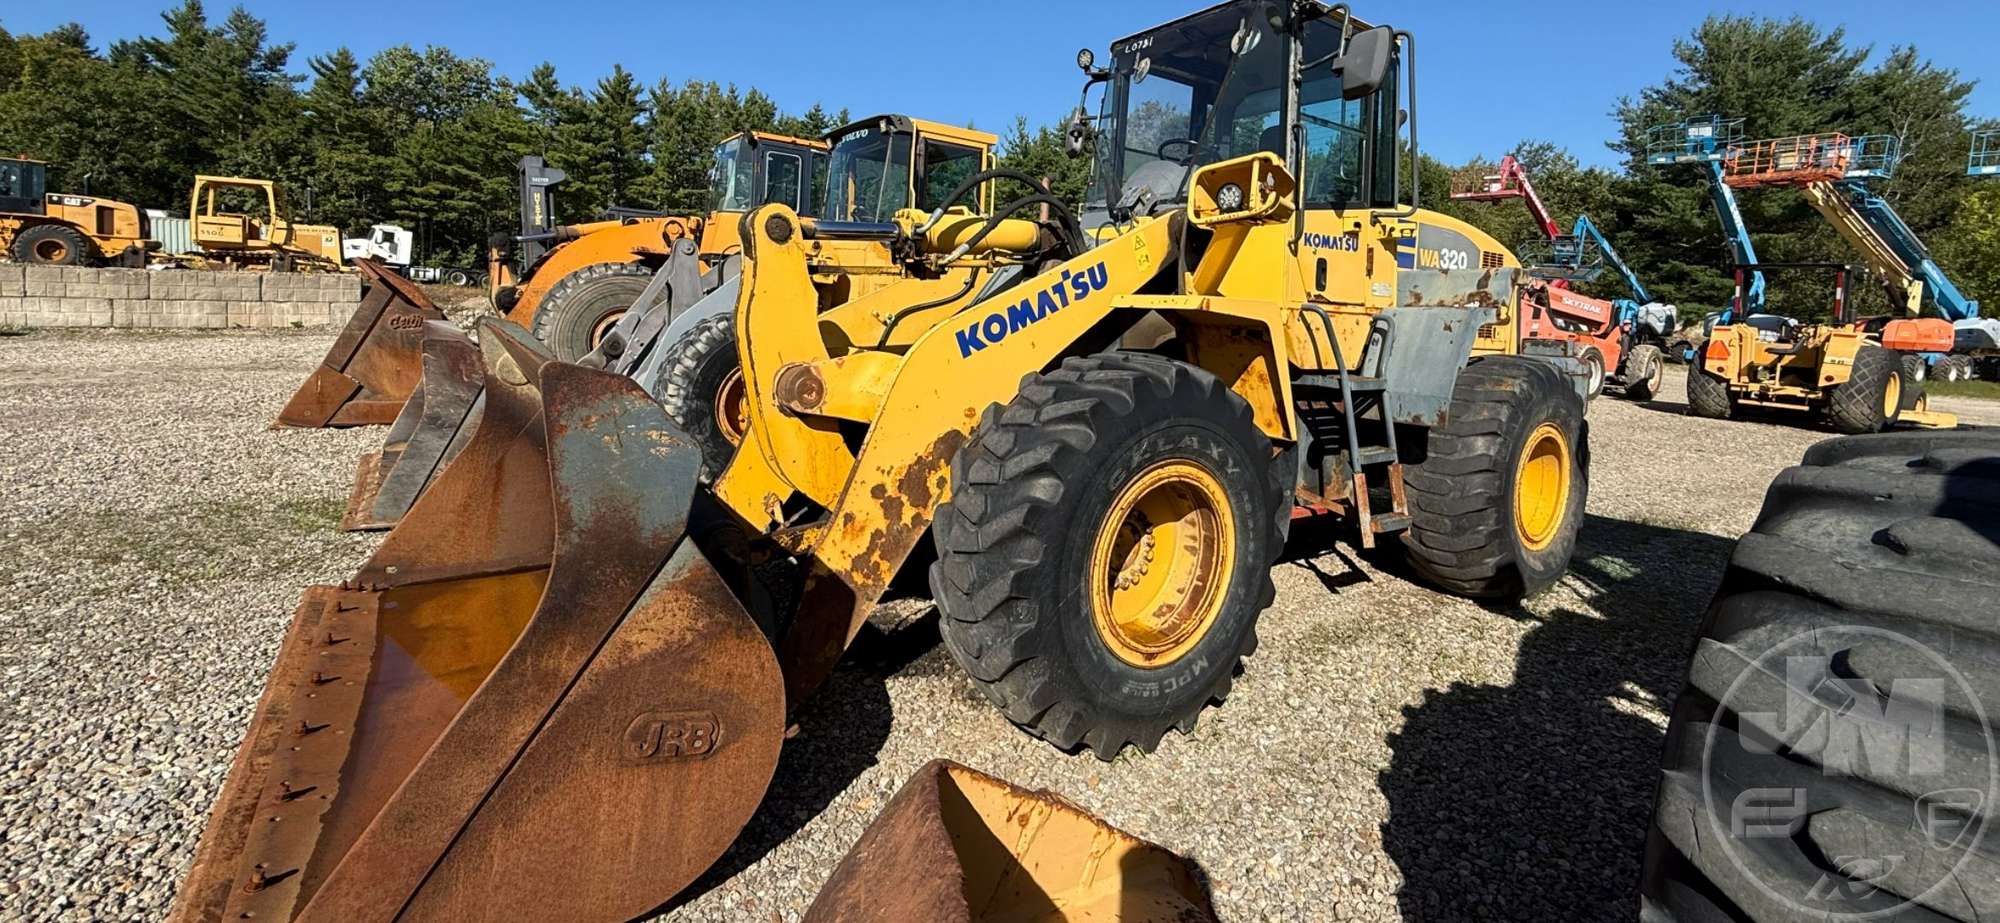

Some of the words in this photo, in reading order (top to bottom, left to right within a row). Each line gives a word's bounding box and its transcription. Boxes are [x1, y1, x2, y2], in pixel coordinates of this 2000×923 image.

[64, 197, 81, 206] CAT
[1303, 232, 1360, 252] KOMATSU
[1419, 247, 1468, 270] WA320
[955, 261, 1109, 359] KOMATSU
[1561, 296, 1602, 315] SKYTRAK
[1163, 655, 1209, 694] MPC
[629, 720, 715, 758] JRB
